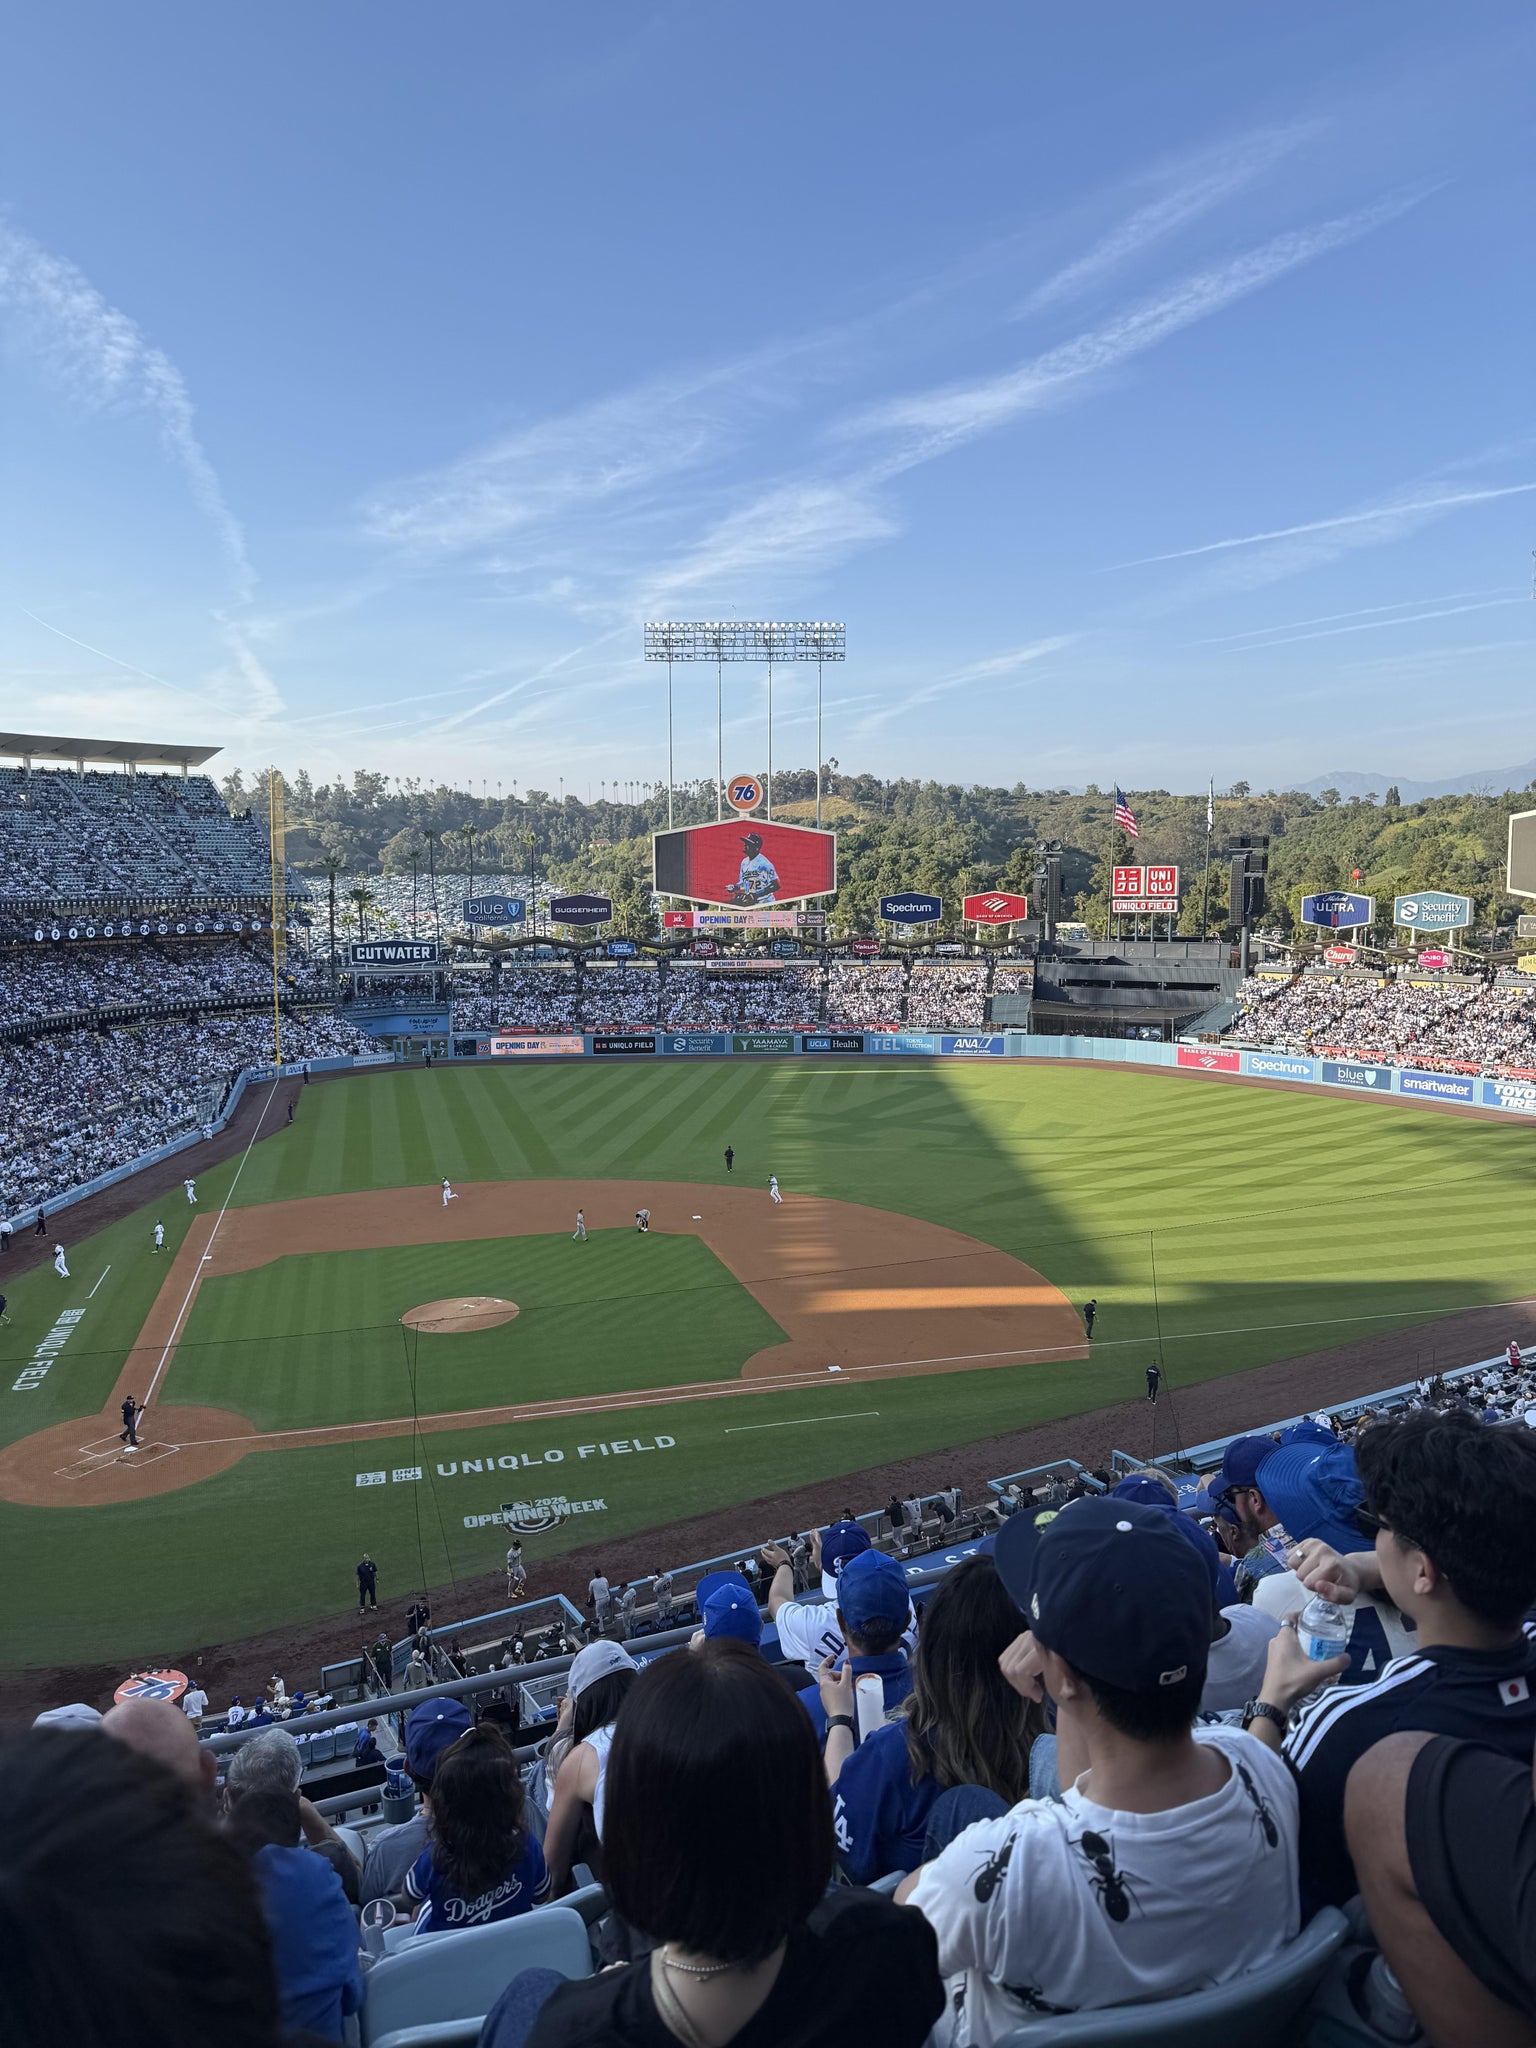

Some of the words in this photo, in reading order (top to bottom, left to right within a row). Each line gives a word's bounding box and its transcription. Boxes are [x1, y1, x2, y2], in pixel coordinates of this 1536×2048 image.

[733, 784, 756, 802] 76
[1150, 870, 1171, 881] UNI
[1150, 881, 1173, 893] QLO
[468, 901, 504, 915] blue
[886, 903, 932, 914] Spectrum
[1116, 902, 1147, 911] UNIQLO
[1148, 902, 1173, 910] FIELD
[1316, 902, 1355, 912] ULTRA
[1421, 901, 1462, 912] Security
[699, 915, 731, 924] OPENING
[733, 915, 748, 924] DAY
[1421, 912, 1456, 922] Benefit
[356, 947, 430, 960] CUTWATER
[1325, 950, 1354, 960] Churu
[495, 1041, 525, 1050] OPENING
[526, 1041, 541, 1050] DAY
[609, 1042, 633, 1050] UNIQLO
[832, 1040, 859, 1048] Health
[872, 1038, 900, 1051] TEL
[954, 1038, 978, 1048] ANA
[1250, 1058, 1305, 1074] Spectrum
[1338, 1066, 1364, 1080] blue
[1403, 1078, 1470, 1096] smartwater
[1494, 1084, 1536, 1099] TOYO
[33, 1325, 76, 1358] UNIQLO
[12, 1360, 54, 1390] FIELD
[436, 1450, 565, 1477] UNIQLO
[577, 1435, 677, 1459] FIELD
[534, 1496, 568, 1505] 2026
[463, 1504, 551, 1529] OPENING
[551, 1498, 609, 1516] WEEK
[118, 1676, 184, 1700] 76
[444, 1873, 523, 1924] Dodgers
